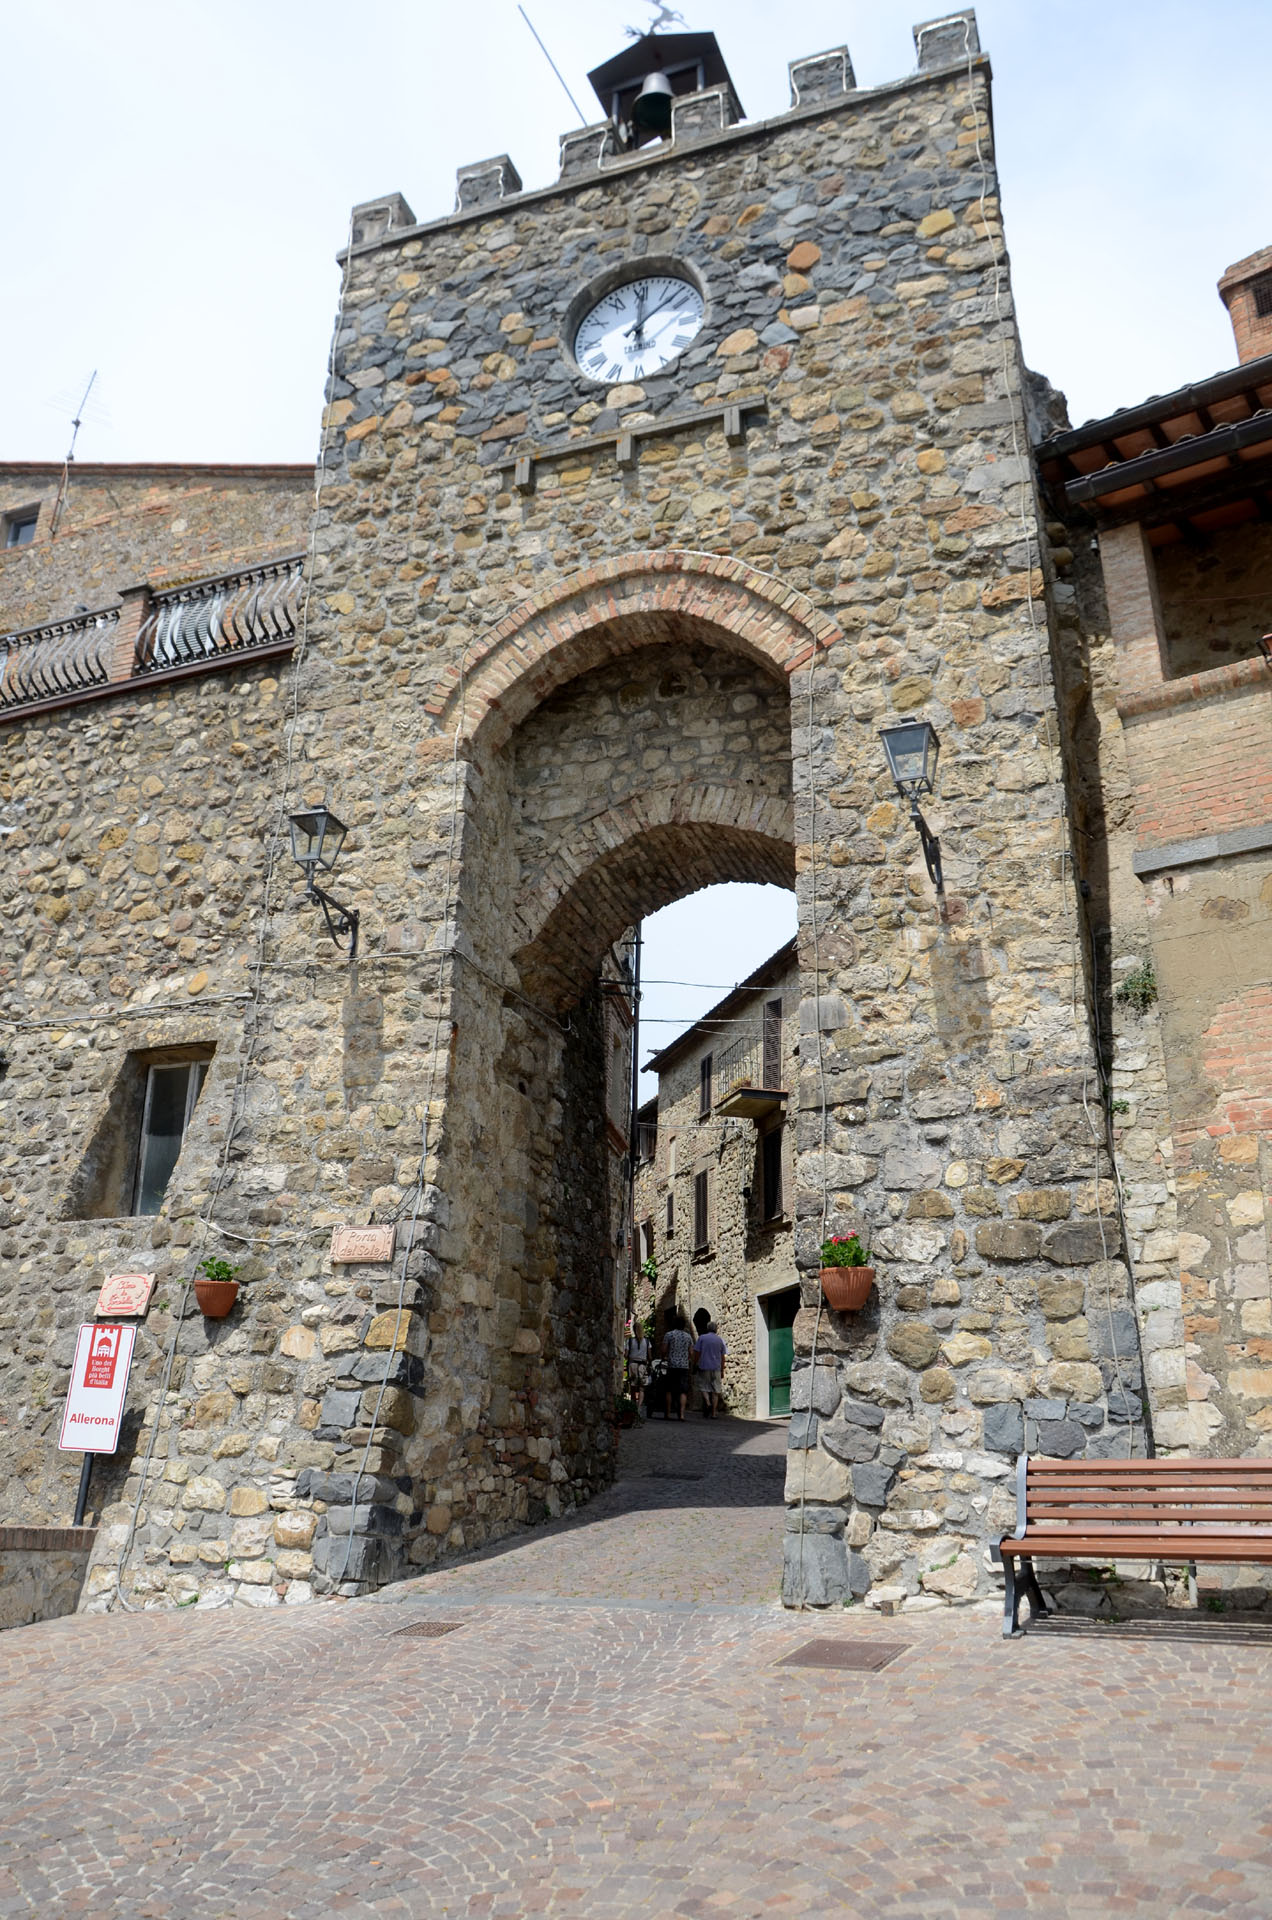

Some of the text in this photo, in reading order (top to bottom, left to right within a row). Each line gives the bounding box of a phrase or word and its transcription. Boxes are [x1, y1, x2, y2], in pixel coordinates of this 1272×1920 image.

[349, 1231, 377, 1242] Porta
[340, 1245, 380, 1257] del Sole
[69, 1412, 115, 1426] Allerona
